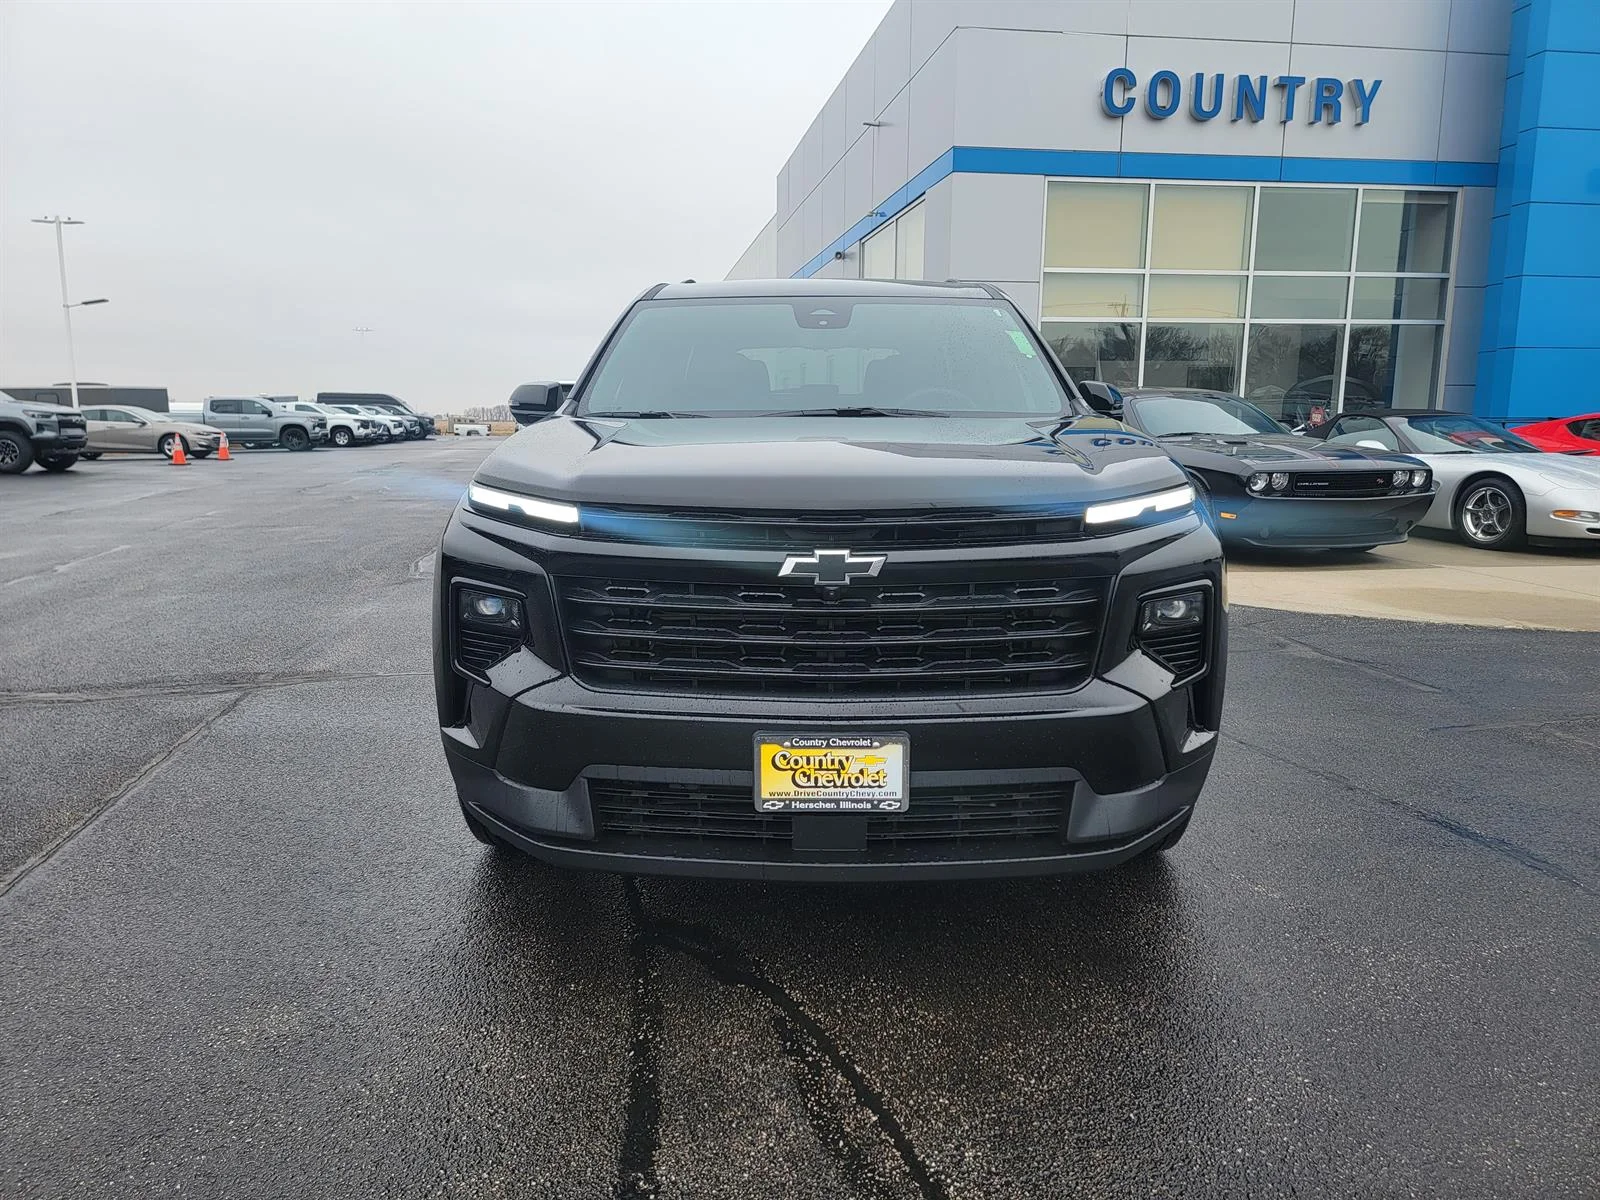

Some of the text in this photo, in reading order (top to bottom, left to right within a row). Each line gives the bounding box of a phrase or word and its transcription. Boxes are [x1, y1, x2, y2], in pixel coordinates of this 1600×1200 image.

[1101, 67, 1383, 126] COUNTRY
[792, 738, 872, 748] Country Chevrolet
[771, 750, 855, 774] Country
[791, 768, 888, 789] Chevrolet
[768, 790, 898, 798] www.DriveCountryChevy.com
[839, 801, 872, 809] Illinois
